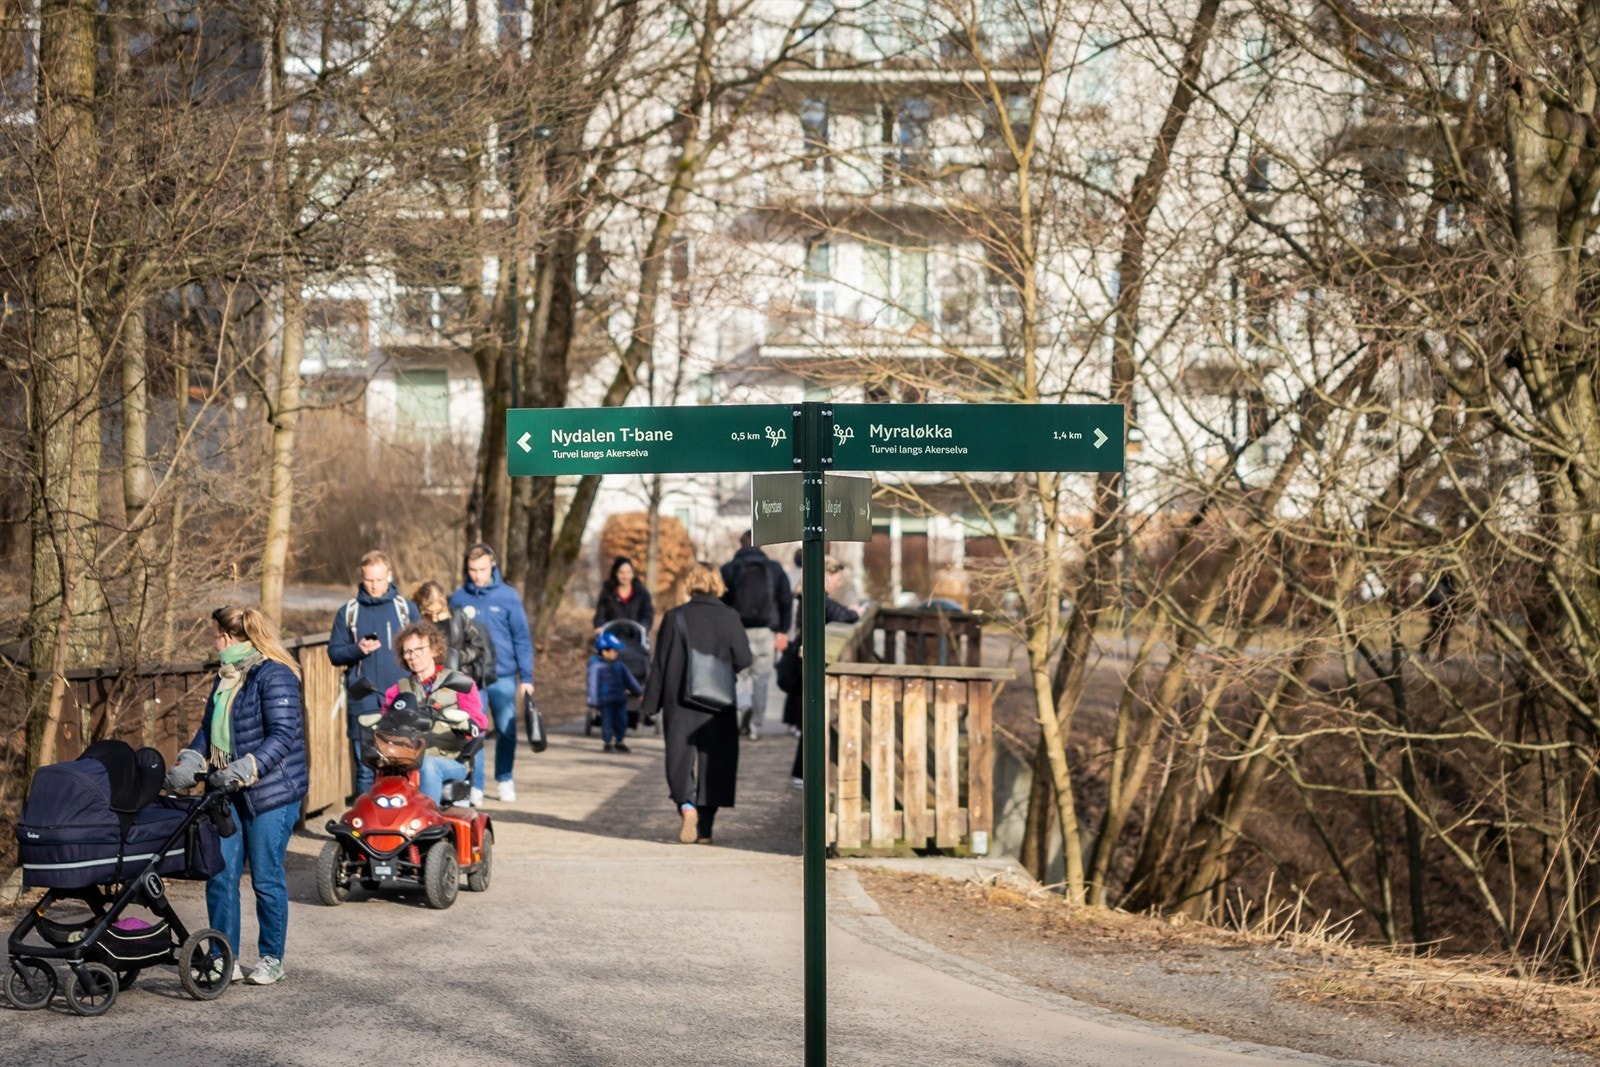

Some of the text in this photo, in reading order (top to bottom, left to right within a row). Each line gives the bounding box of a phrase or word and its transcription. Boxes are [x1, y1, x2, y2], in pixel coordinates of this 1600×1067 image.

[551, 427, 674, 447] Nydalen T-bane
[731, 432, 760, 442] 0,5 km
[869, 424, 953, 442] Myraløkka
[1053, 431, 1082, 441] 1,4 km
[551, 448, 649, 461] Turvei langs Akerselva
[870, 444, 968, 456] Turvei langs Akerselva
